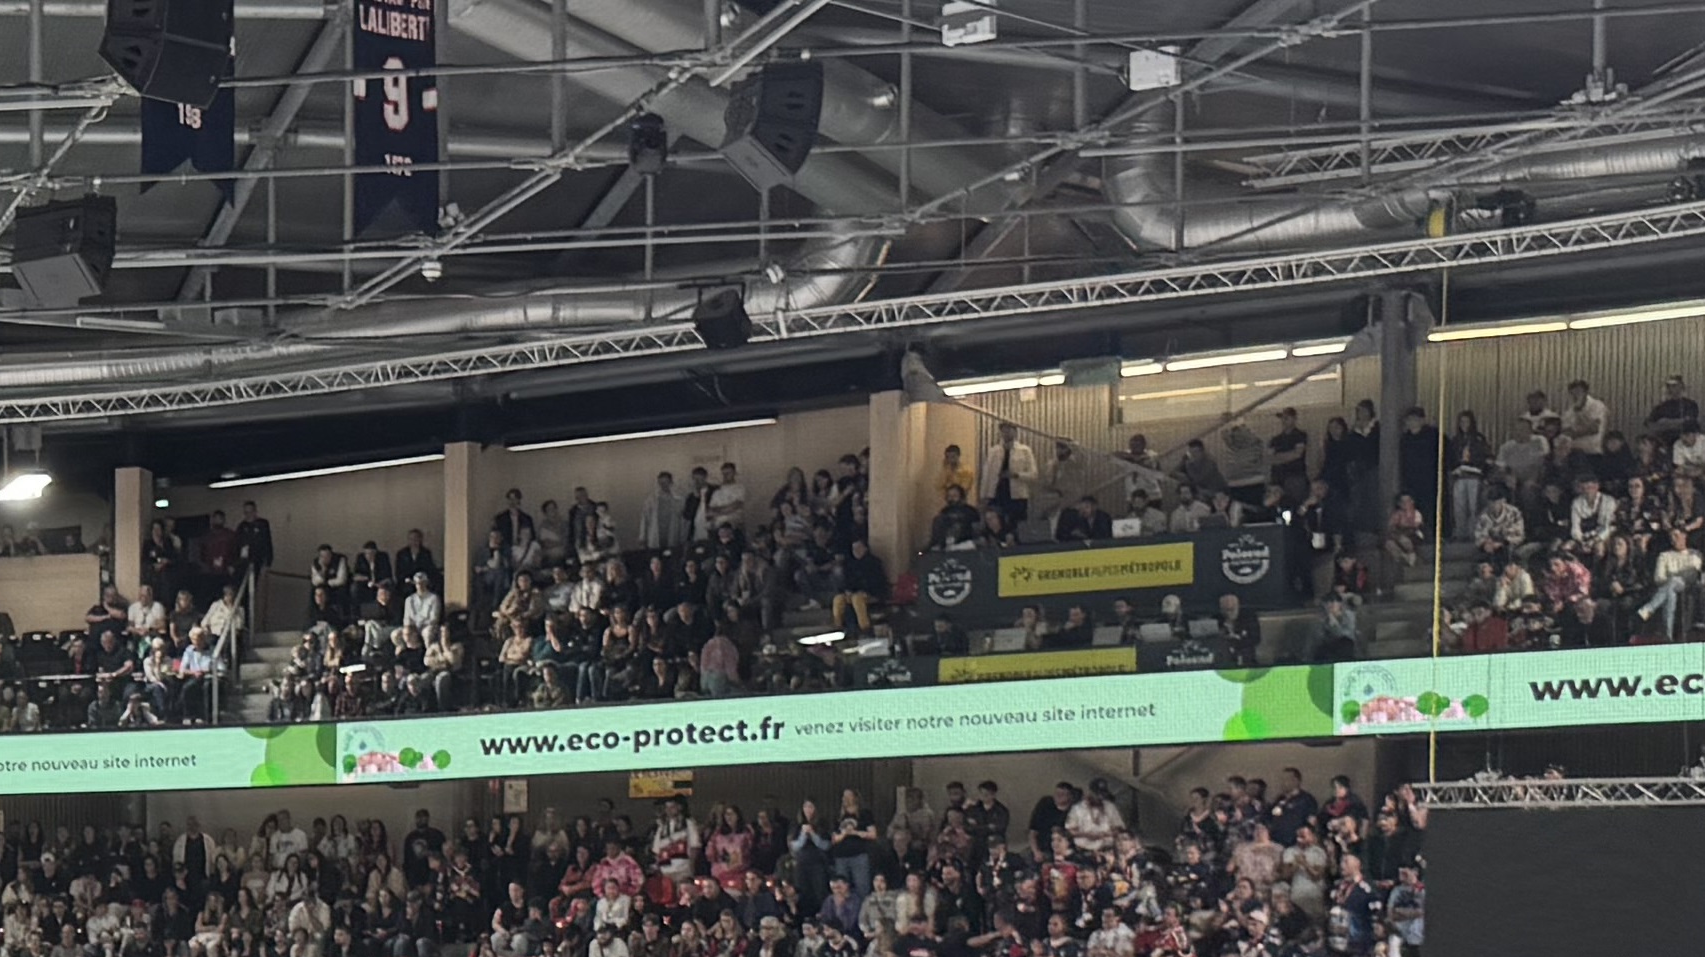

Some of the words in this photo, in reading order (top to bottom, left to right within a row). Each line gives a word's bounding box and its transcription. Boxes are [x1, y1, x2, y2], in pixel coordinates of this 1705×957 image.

[383, 57, 409, 131] 9
[480, 716, 784, 755] www.eco-protect.fr
[795, 722, 844, 736] venez
[849, 716, 900, 733] visiter
[907, 714, 954, 730] notre
[960, 710, 1037, 727] nouveau
[1042, 706, 1075, 723] site
[1080, 702, 1156, 720] internet
[32, 757, 98, 772] nouveau
[103, 755, 130, 769] site
[135, 753, 196, 768] internet
